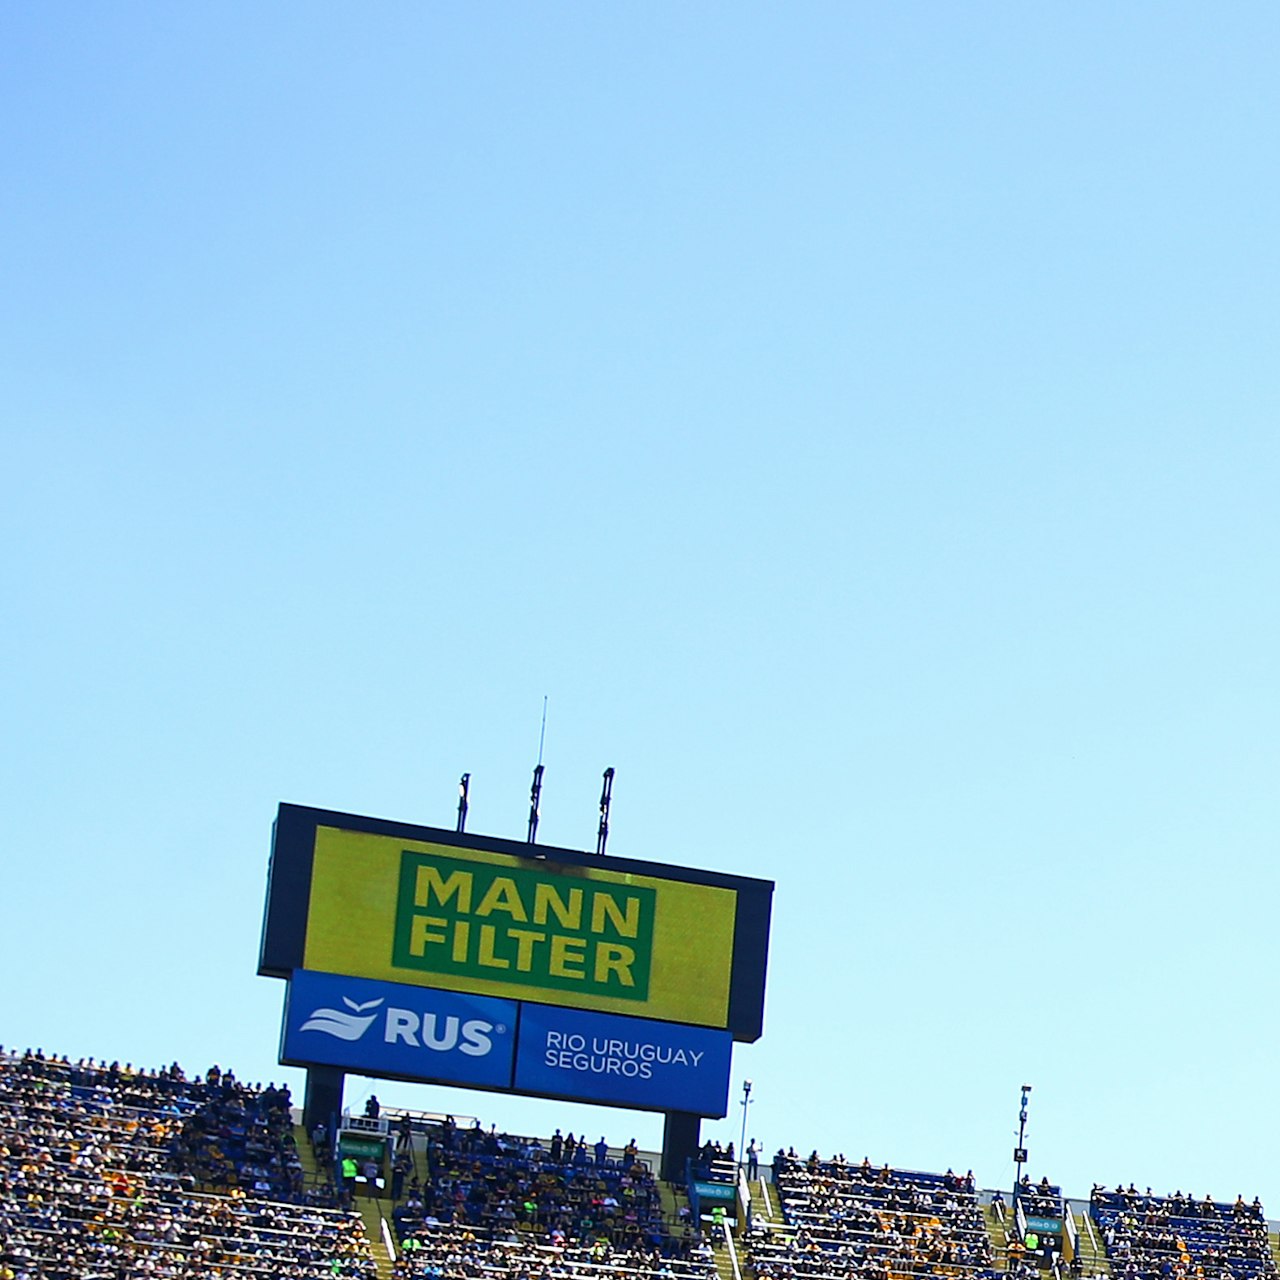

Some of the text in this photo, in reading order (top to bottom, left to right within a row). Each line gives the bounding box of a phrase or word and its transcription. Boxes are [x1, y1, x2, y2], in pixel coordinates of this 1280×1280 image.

[414, 865, 641, 939] MANN
[408, 915, 636, 987] FILTER
[384, 1006, 493, 1057] RUS
[546, 1031, 704, 1068] RIO URUGUAY
[545, 1050, 653, 1080] SEGUROS
